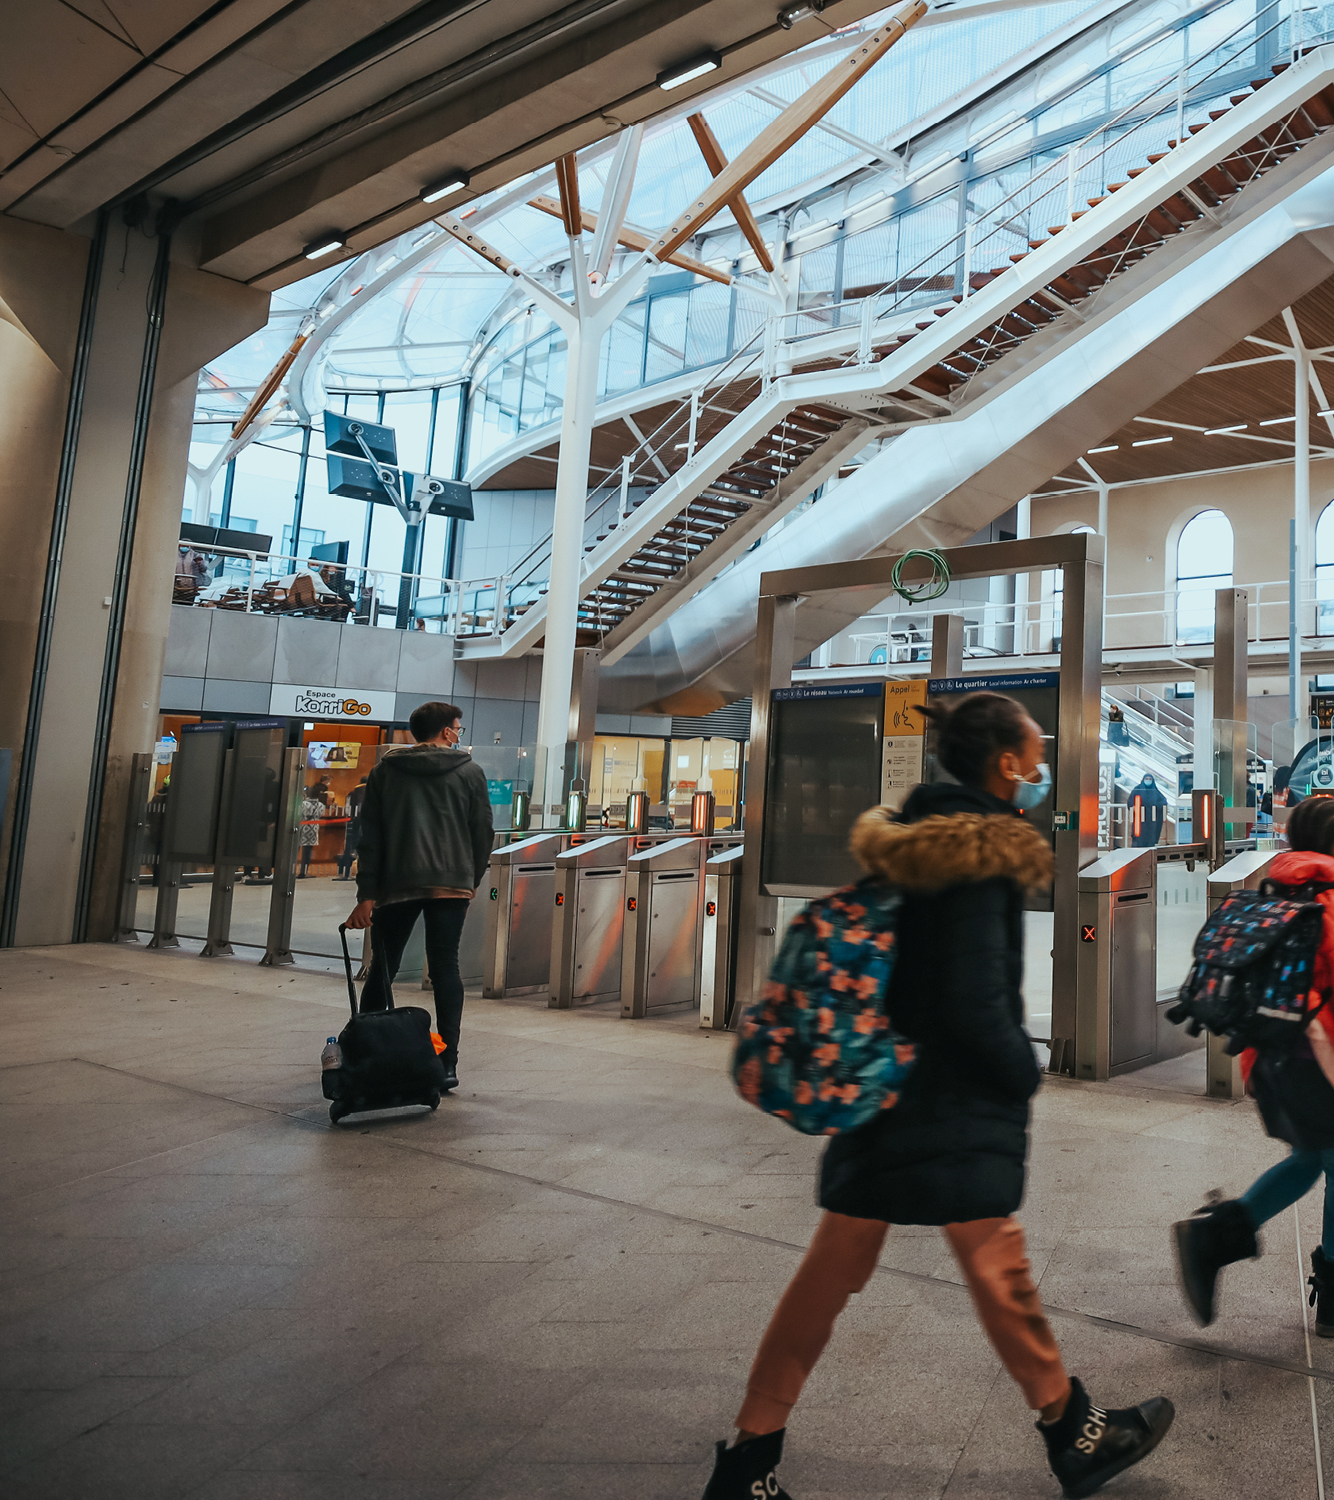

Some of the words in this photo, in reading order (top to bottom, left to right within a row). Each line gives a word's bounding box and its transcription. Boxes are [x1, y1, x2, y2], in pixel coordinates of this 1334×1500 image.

[890, 685, 910, 694] Appel
[964, 680, 987, 689] quartier
[306, 690, 336, 698] Espace
[295, 695, 371, 716] KorriGo
[1075, 1404, 1107, 1454] SCH
[751, 1472, 778, 1500] SC
